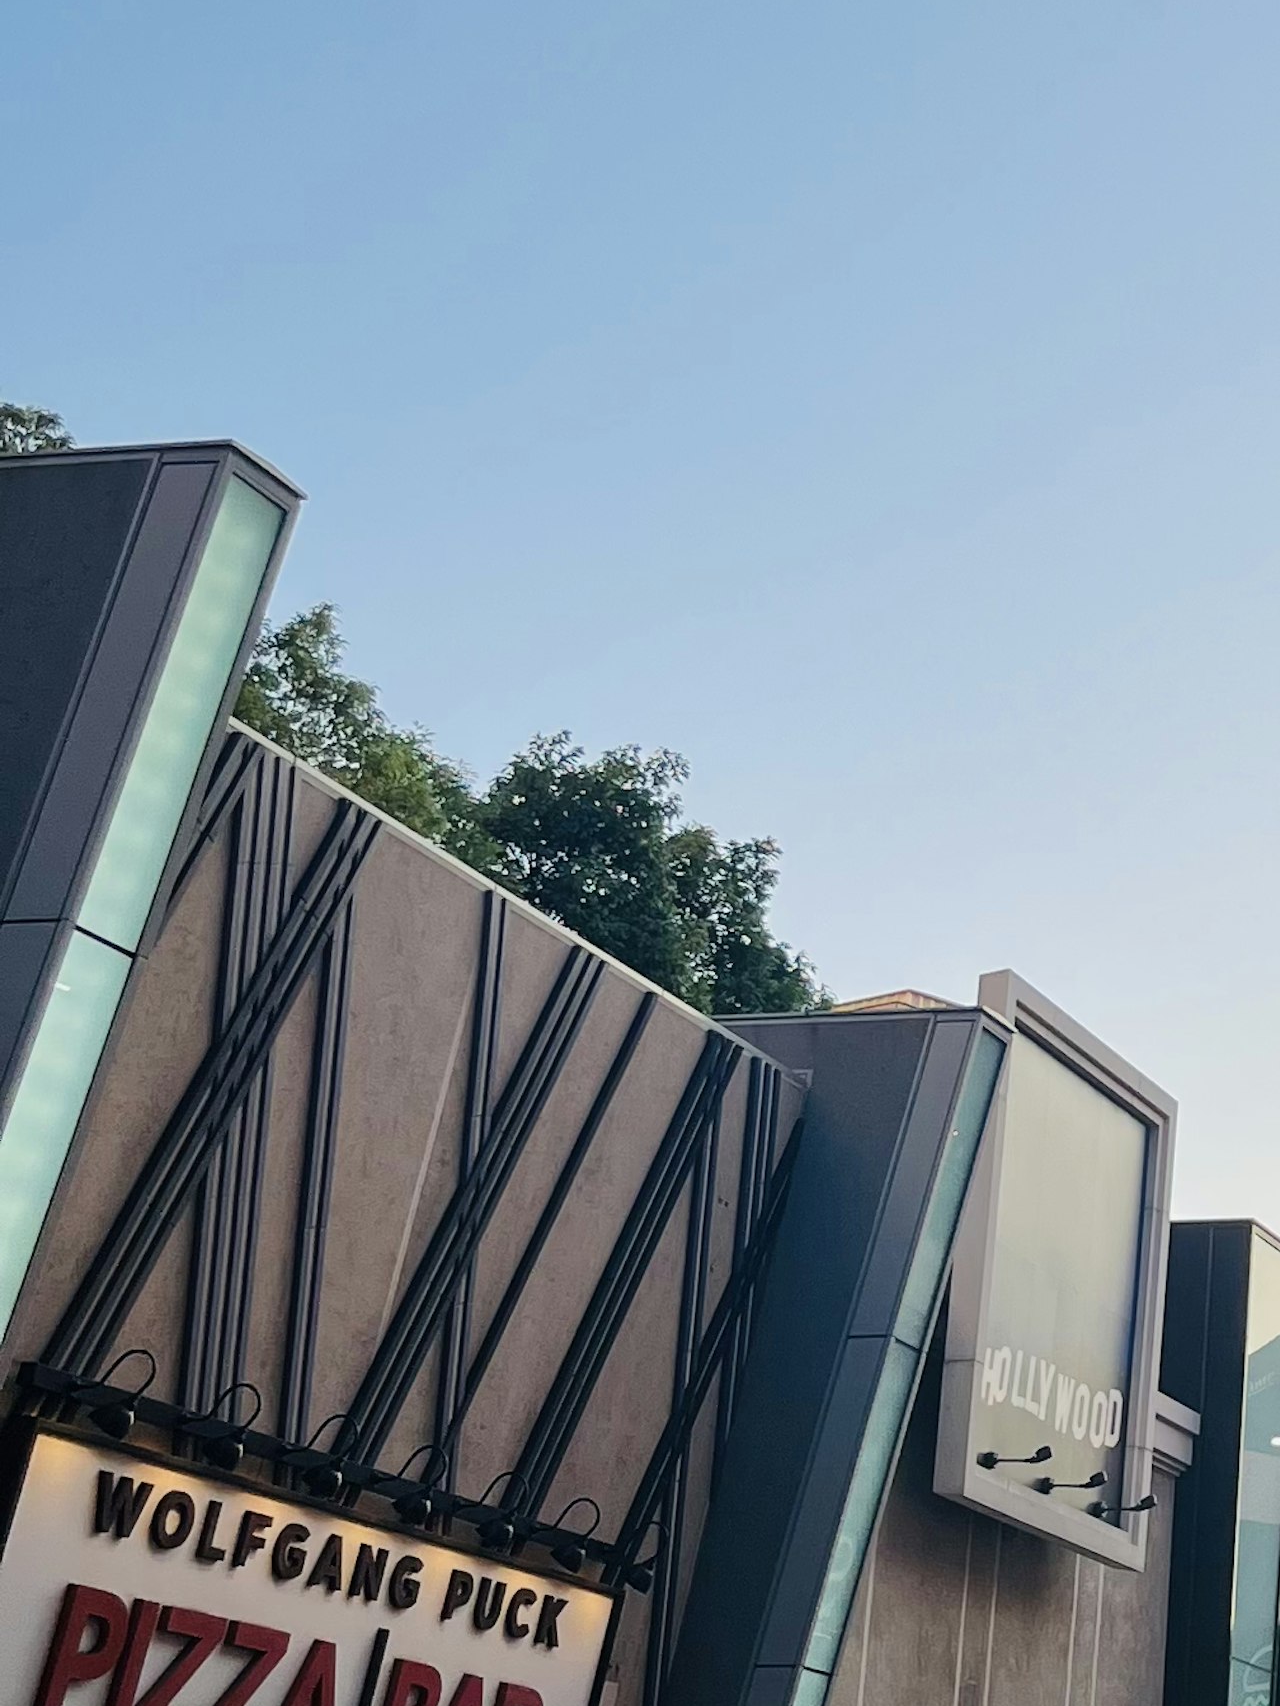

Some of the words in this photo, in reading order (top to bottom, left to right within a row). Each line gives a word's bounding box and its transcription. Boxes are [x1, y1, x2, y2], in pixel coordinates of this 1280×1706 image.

[981, 1345, 1123, 1449] HOLLYWOOD
[94, 1470, 423, 1609] WOLFGANG
[439, 1568, 568, 1648] PUCK
